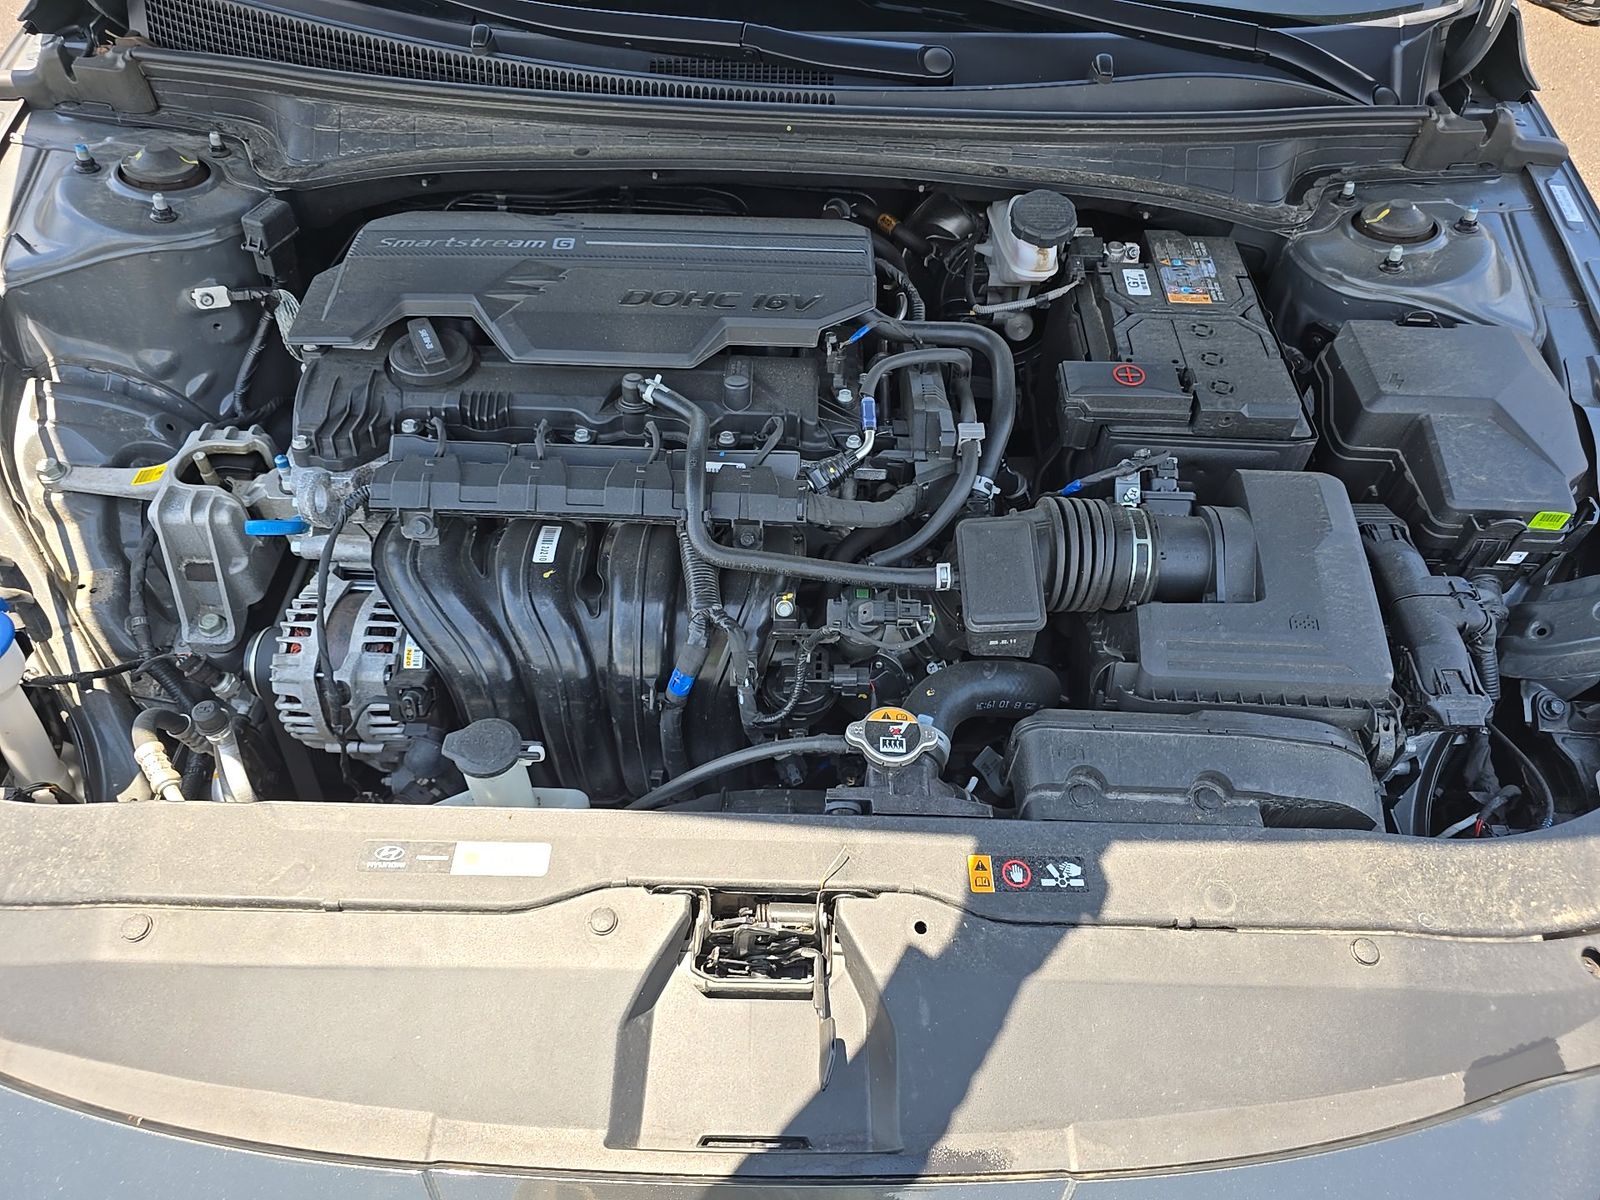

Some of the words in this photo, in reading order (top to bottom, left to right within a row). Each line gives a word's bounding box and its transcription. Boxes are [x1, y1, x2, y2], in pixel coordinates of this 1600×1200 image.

[375, 236, 547, 249] Smartstream
[552, 237, 576, 250] G
[1126, 272, 1140, 289] G7
[617, 287, 743, 309] DOHC
[751, 292, 825, 312] 16V
